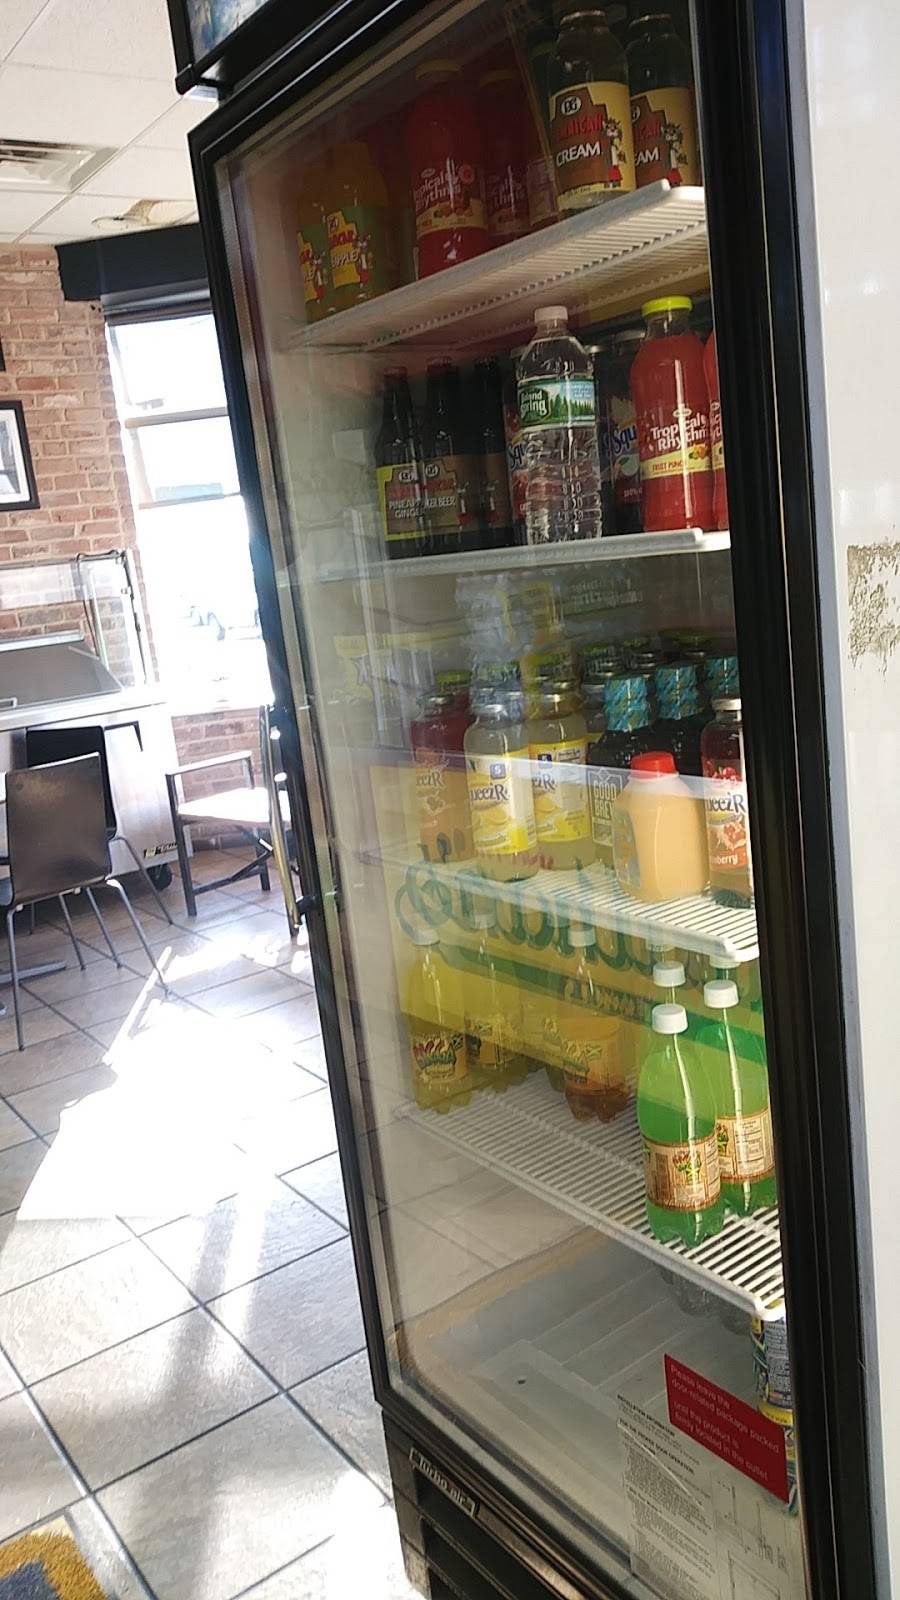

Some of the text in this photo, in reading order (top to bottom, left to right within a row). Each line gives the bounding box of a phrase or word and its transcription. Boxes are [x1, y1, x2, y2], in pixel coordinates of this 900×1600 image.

[556, 141, 601, 167] CREAM
[651, 412, 701, 441] Tropcal
[668, 459, 684, 469] PUNC
[593, 780, 617, 800] GOOD
[671, 1365, 694, 1387] Please
[718, 1395, 730, 1409] the
